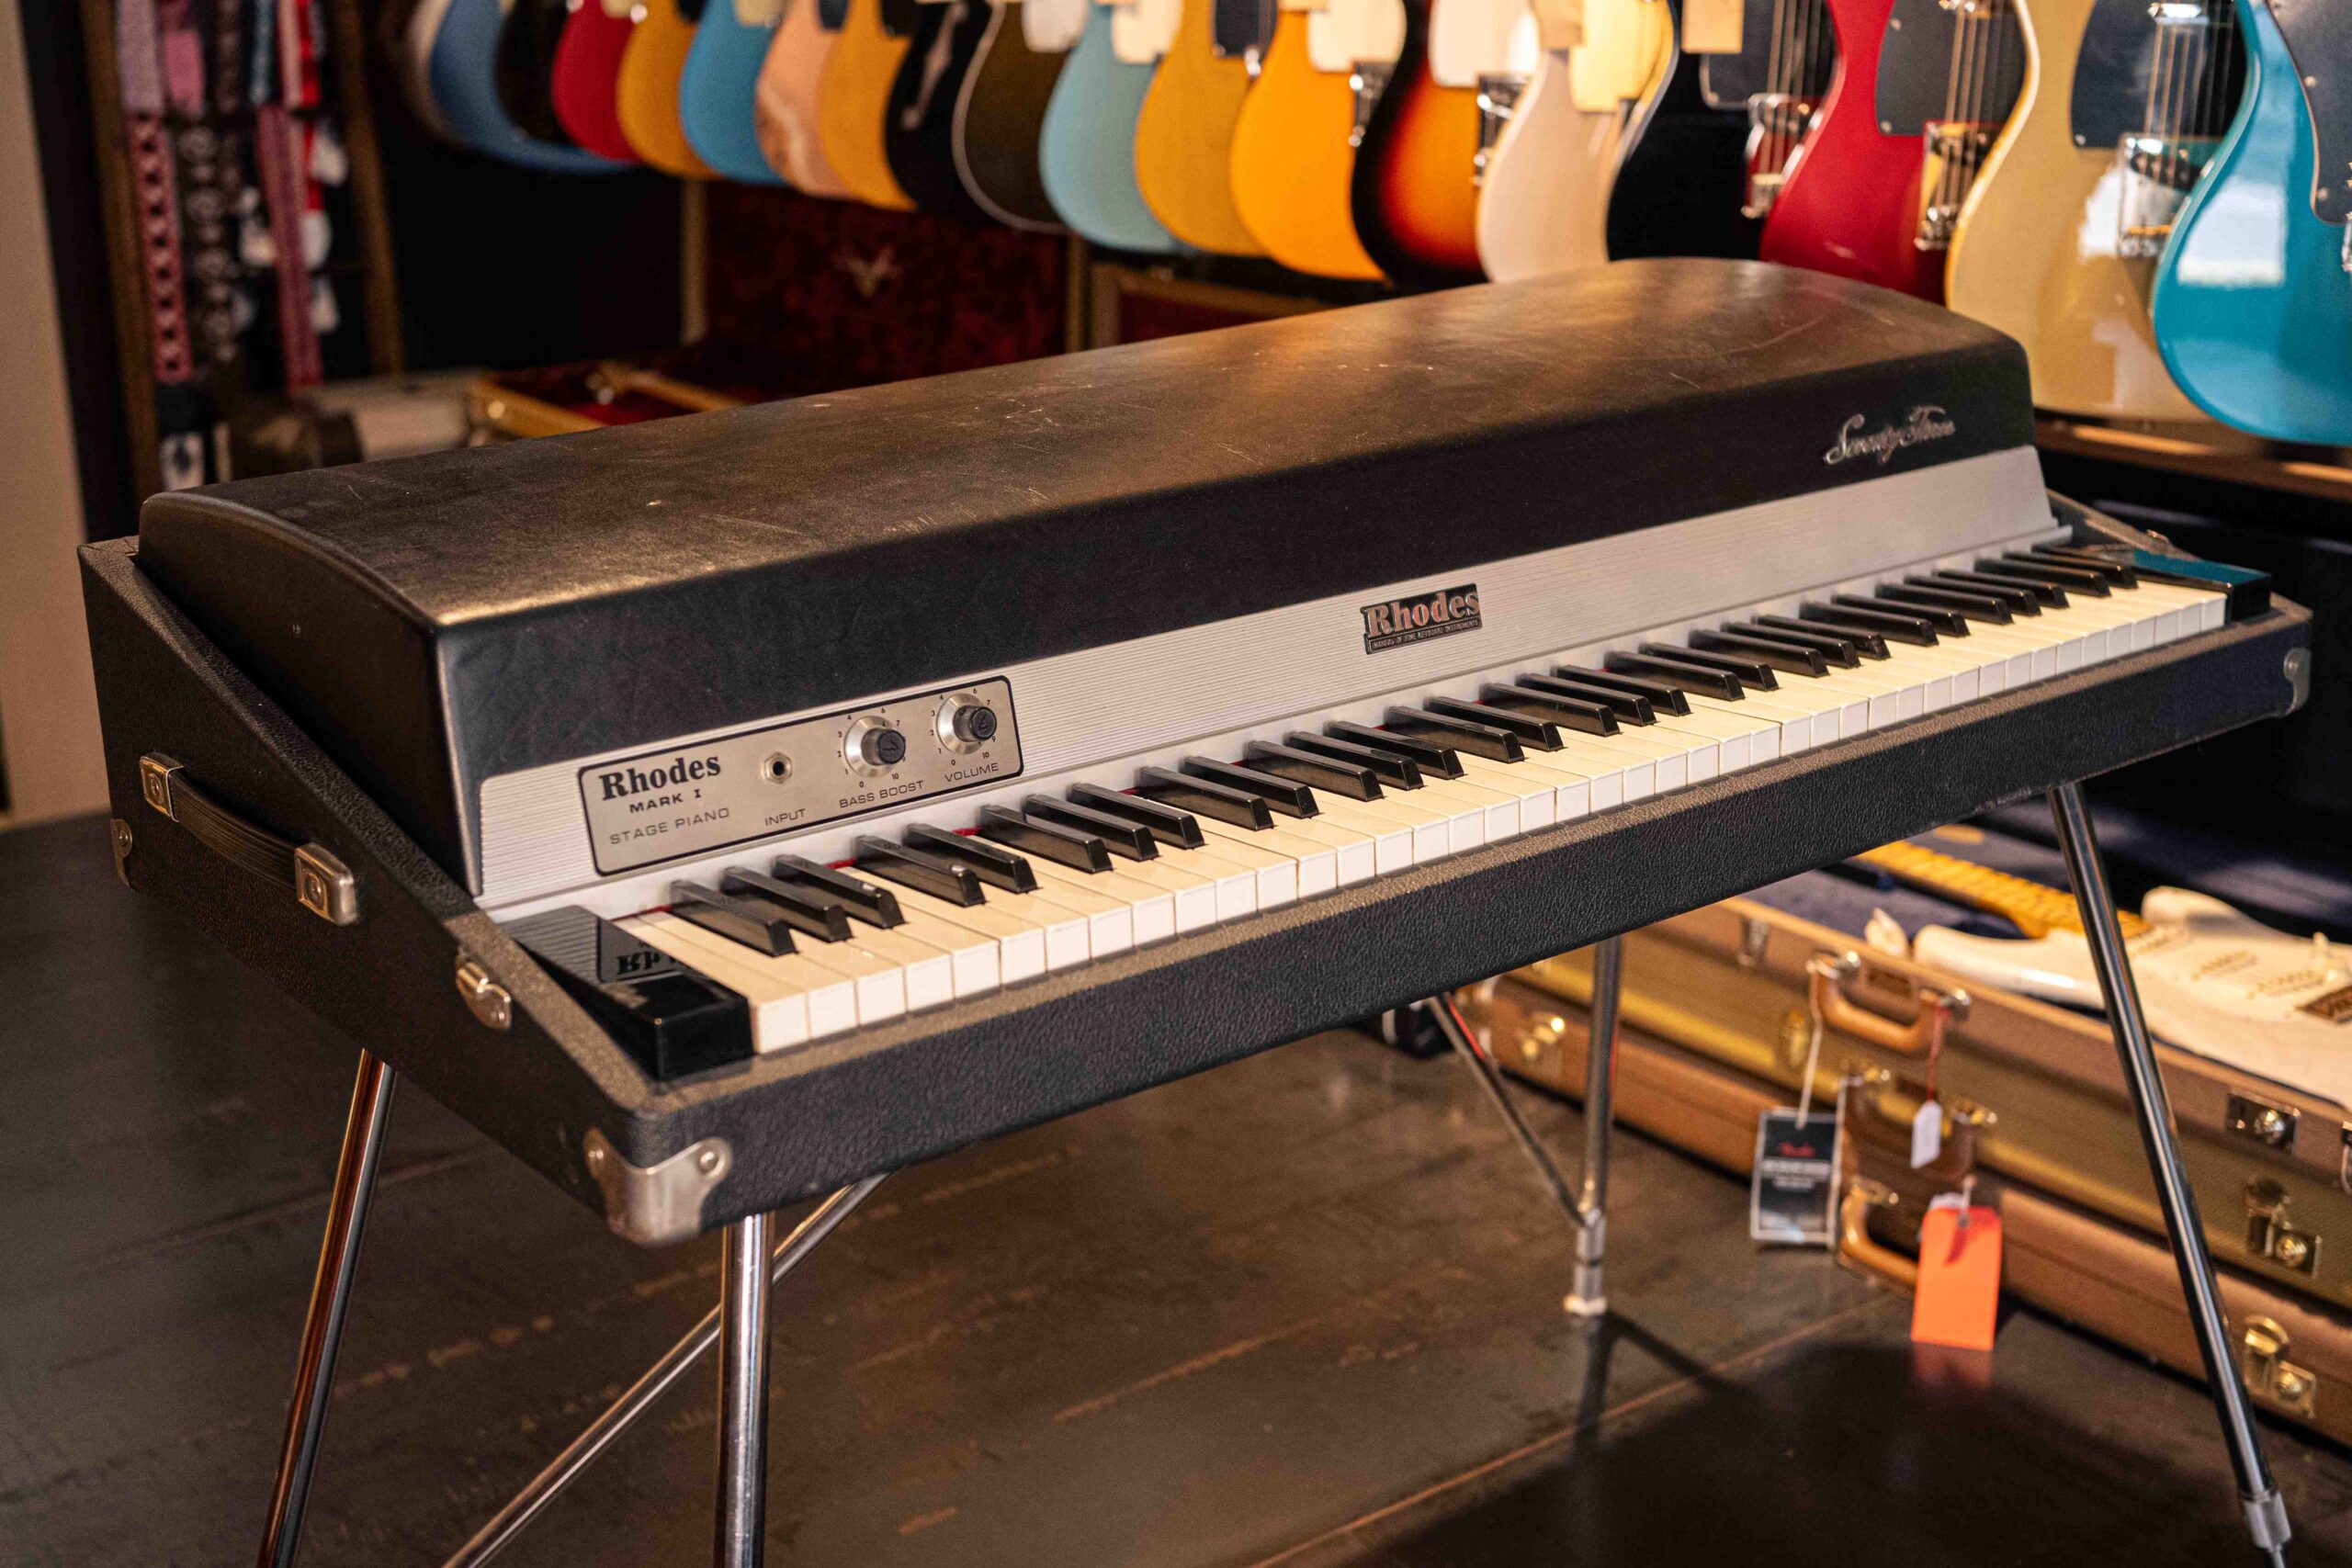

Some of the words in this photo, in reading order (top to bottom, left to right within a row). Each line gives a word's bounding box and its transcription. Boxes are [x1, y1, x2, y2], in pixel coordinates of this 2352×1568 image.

[1366, 591, 1480, 637] Rhodes
[598, 756, 721, 801] Rhodes
[944, 762, 1000, 783] VOLUME
[628, 792, 684, 814] MARK
[694, 788, 702, 799] I
[838, 792, 876, 808] BASS
[878, 780, 924, 799] BOOST
[609, 821, 669, 845] STAGE
[674, 807, 729, 829] PIANO
[764, 807, 806, 826] INPUT
